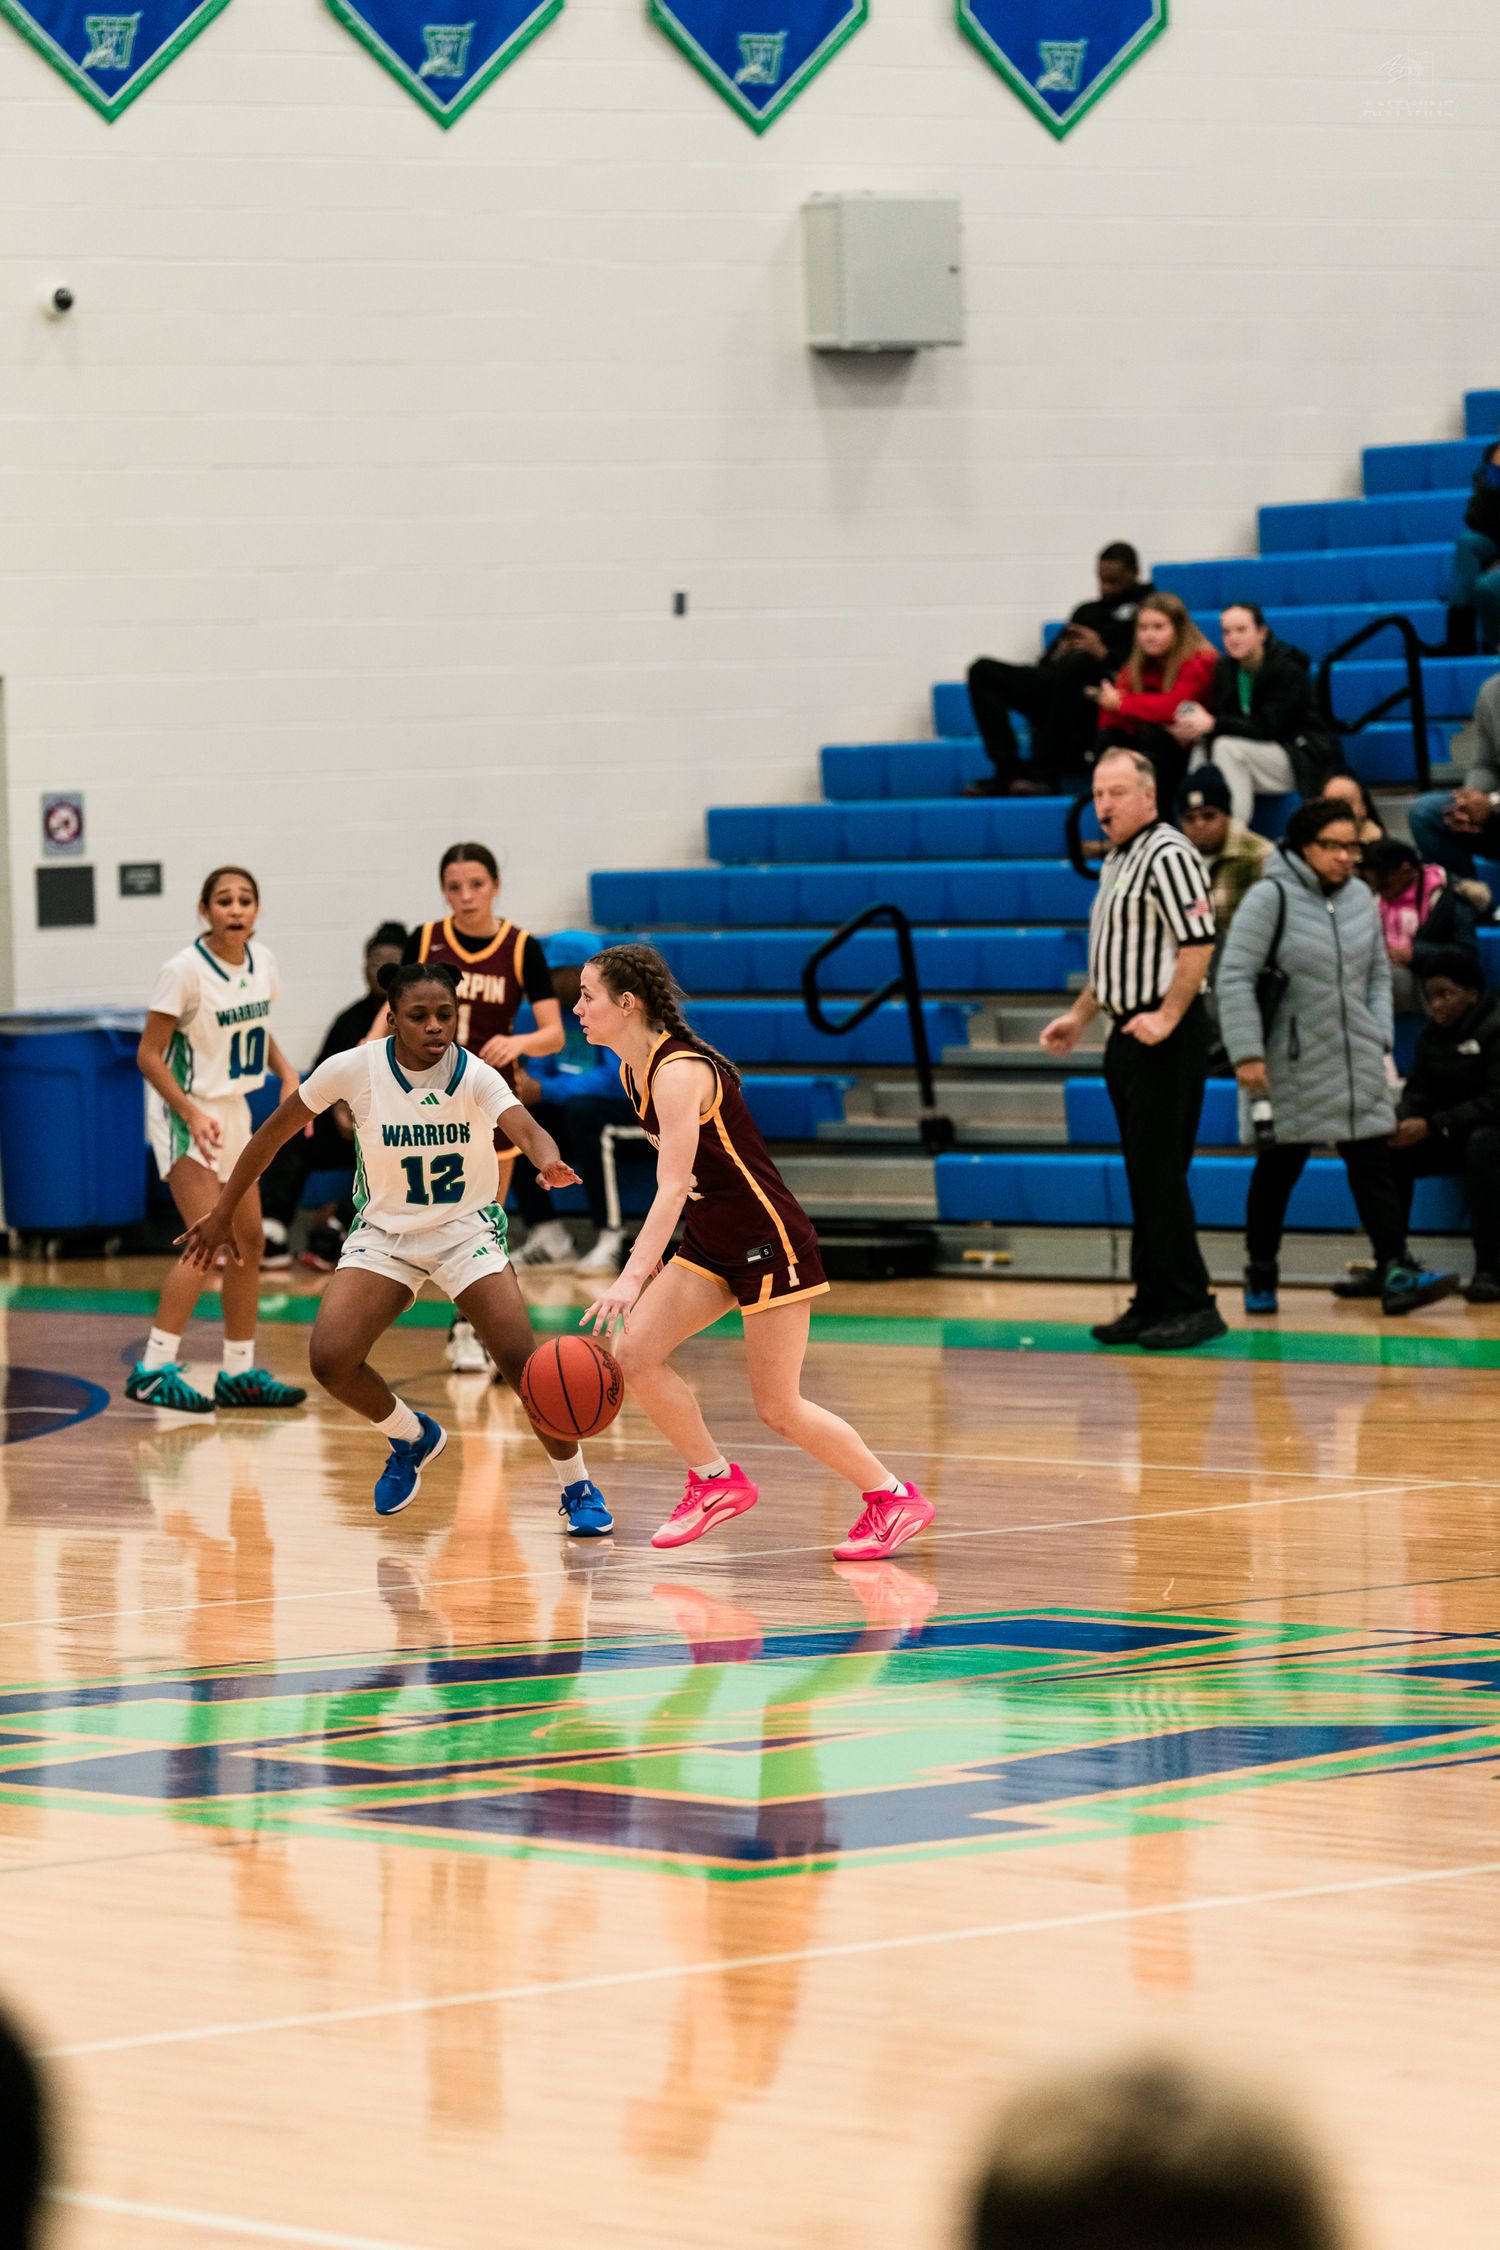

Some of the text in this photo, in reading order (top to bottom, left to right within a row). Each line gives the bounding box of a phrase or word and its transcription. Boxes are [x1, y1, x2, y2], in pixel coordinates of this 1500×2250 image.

[456, 971, 506, 1004] RPIN
[215, 1000, 270, 1028] WARRIOR
[228, 1026, 266, 1080] 10
[382, 1122, 470, 1147] WARRIOR
[400, 1152, 466, 1206] 12
[763, 1248, 770, 1256] S
[594, 1344, 620, 1407] Rawli
